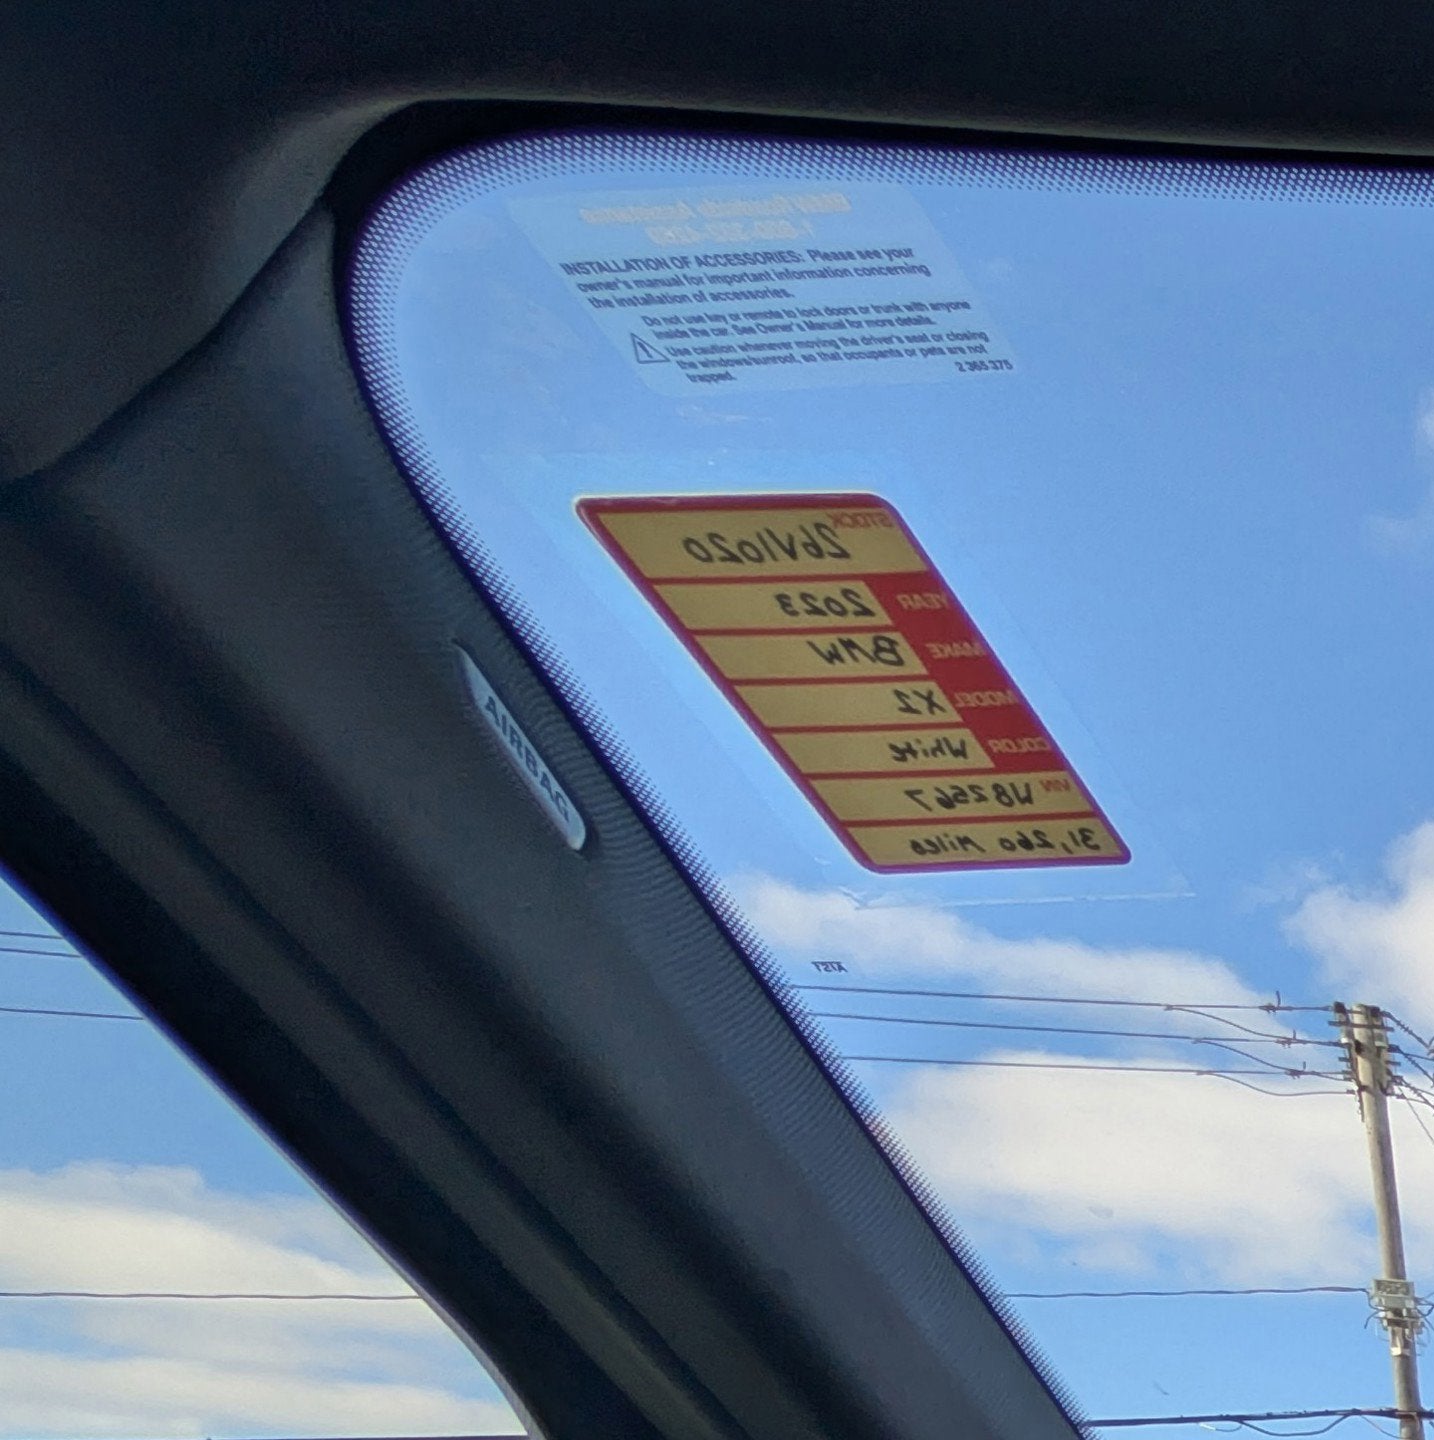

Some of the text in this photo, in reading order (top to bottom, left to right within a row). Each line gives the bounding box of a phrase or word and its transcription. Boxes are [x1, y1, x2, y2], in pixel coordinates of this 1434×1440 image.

[559, 247, 914, 275] INSTALLATION OF ACCESSORIES: Please see your
[577, 261, 931, 292] owner's manual for important information concerning
[588, 286, 795, 309] the installation of accessories.
[641, 315, 662, 328] Do
[660, 314, 683, 326] not
[955, 361, 967, 372] 2
[484, 695, 570, 823] AIRBAG
